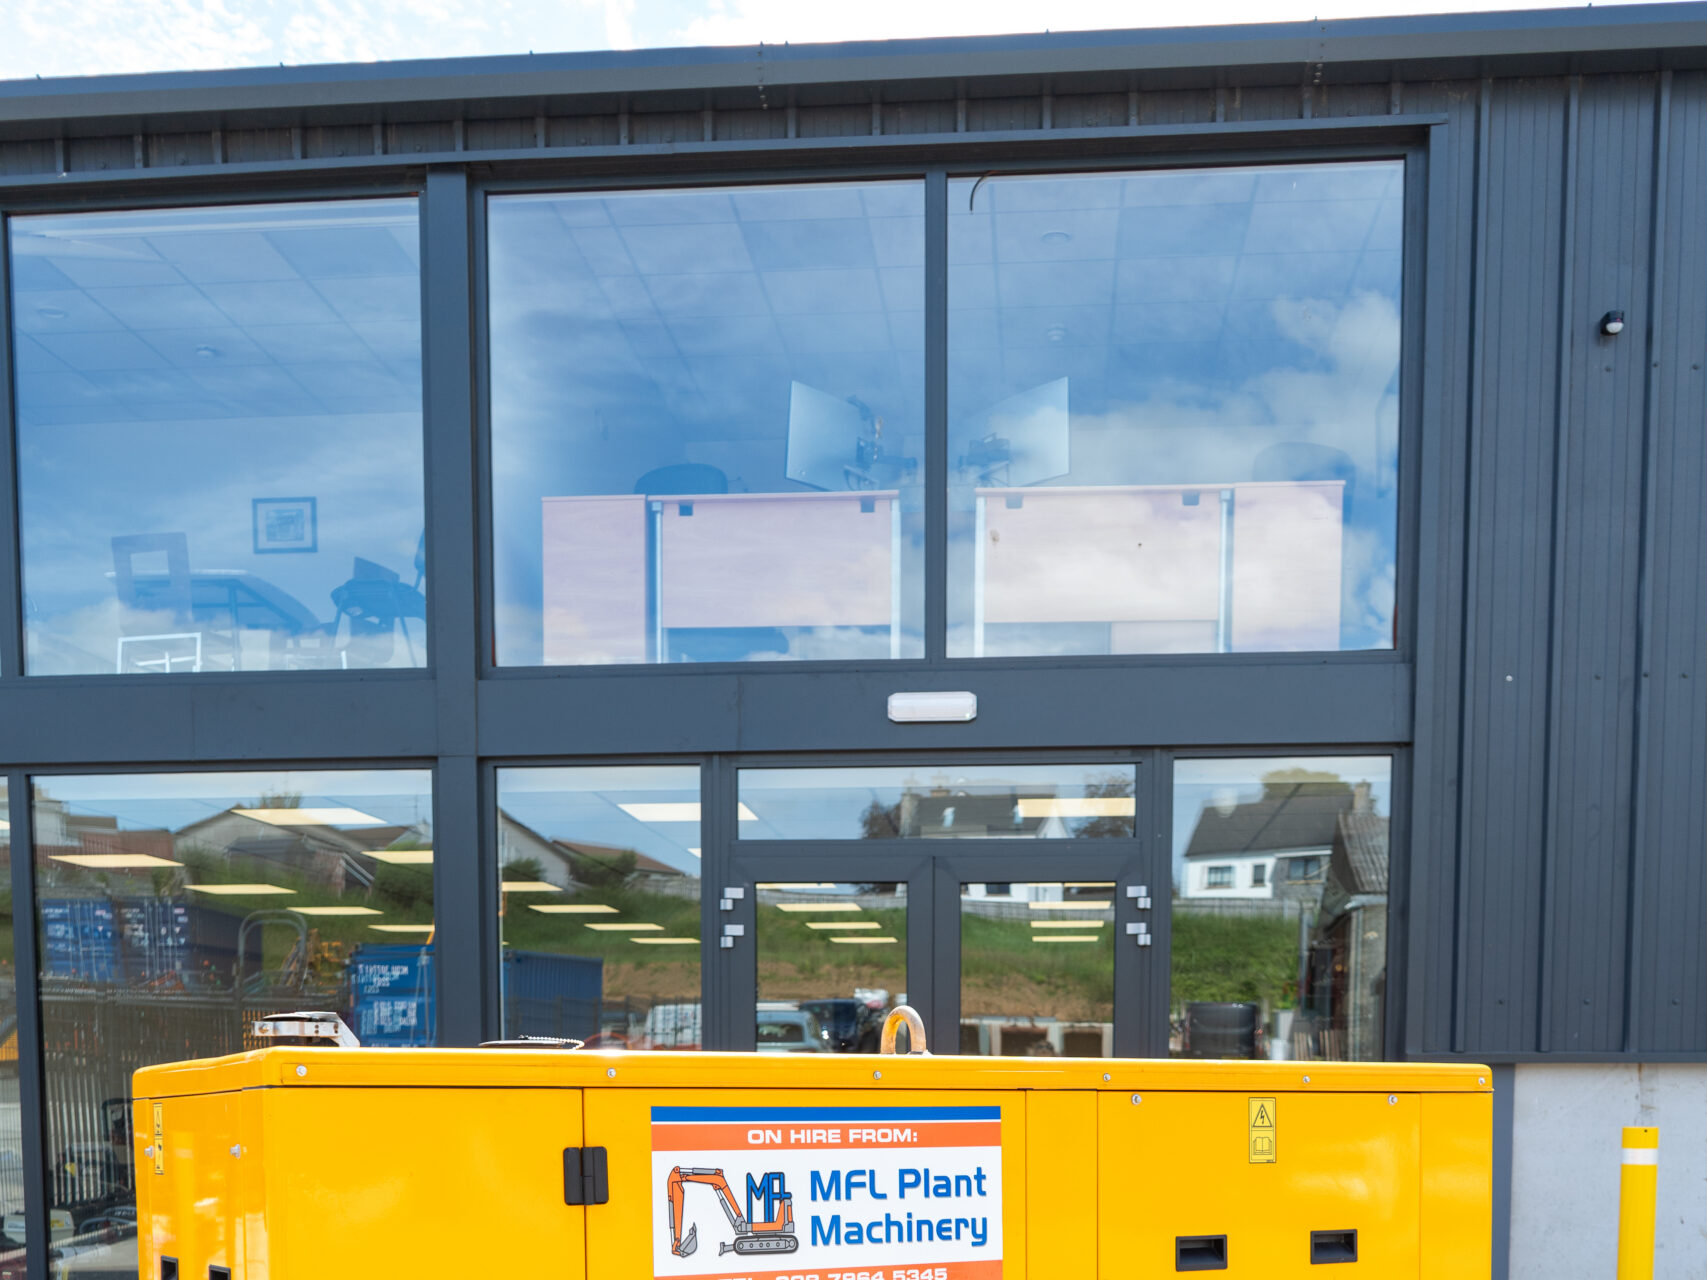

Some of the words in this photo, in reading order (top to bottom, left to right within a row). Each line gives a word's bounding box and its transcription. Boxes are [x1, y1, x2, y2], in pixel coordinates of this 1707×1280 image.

[747, 1129, 782, 1144] ON
[790, 1128, 841, 1144] HIRE
[849, 1128, 918, 1143] FROM:
[810, 1169, 887, 1201] MFL
[899, 1166, 987, 1198] Plant
[811, 1211, 988, 1247] Machinery
